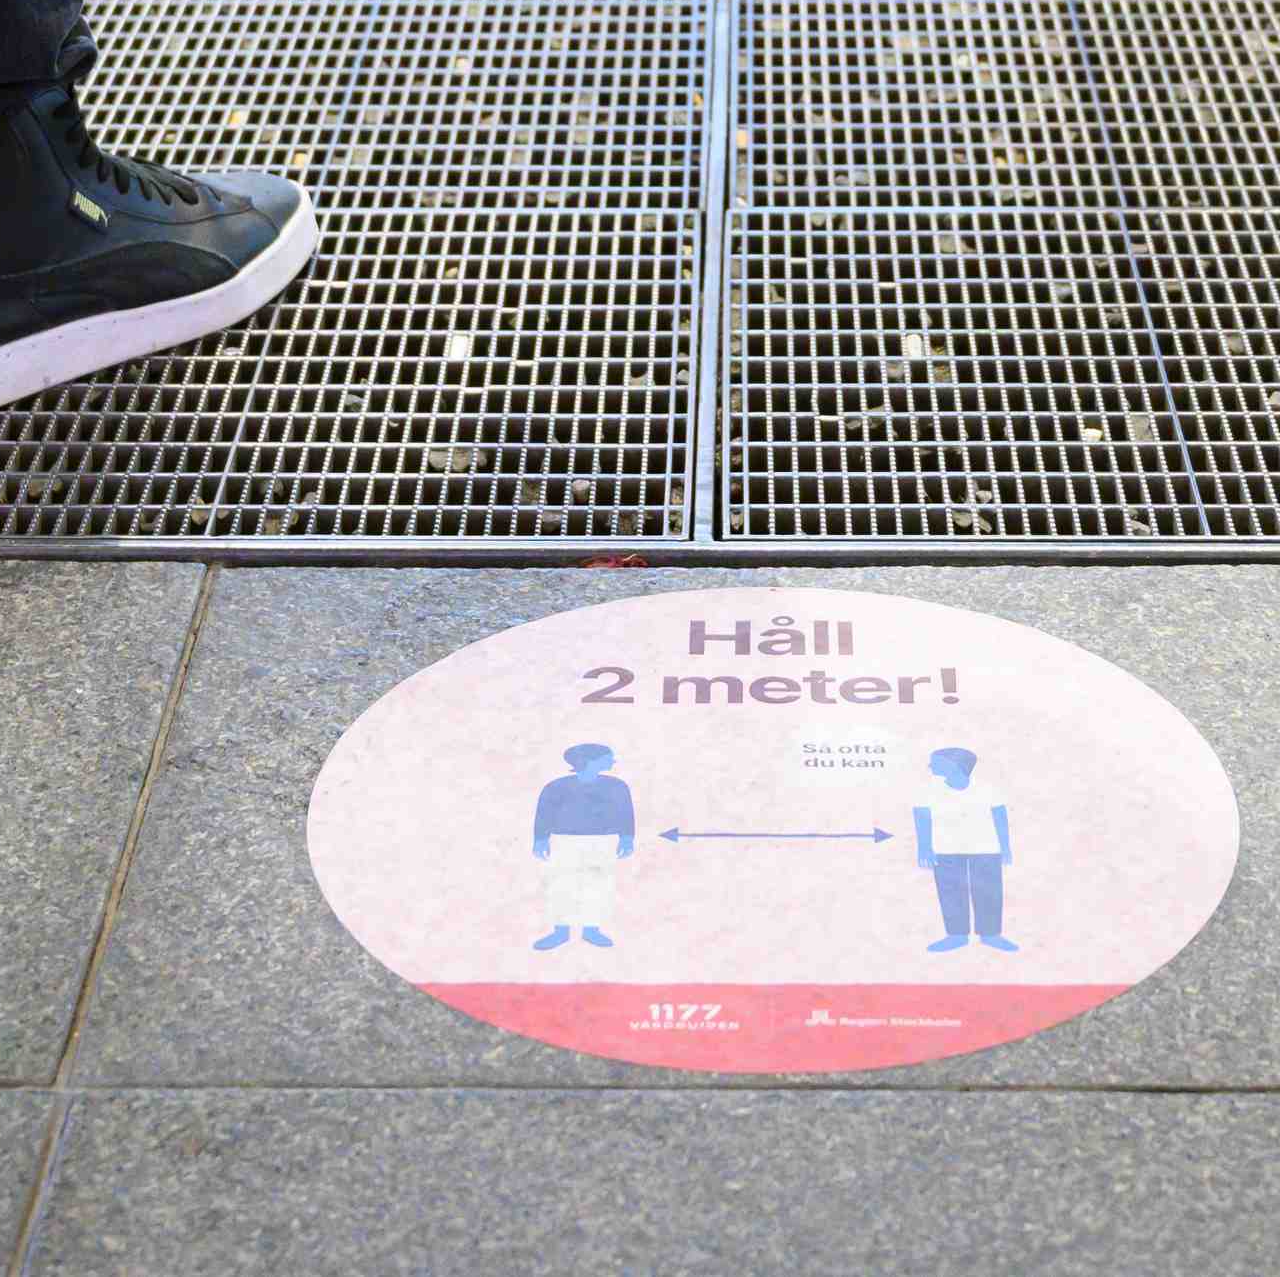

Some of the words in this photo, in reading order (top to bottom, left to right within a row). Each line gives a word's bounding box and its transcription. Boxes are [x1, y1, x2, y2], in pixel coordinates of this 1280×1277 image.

[688, 615, 854, 656] Håll
[580, 666, 636, 705] 2
[662, 667, 961, 705] meter!
[838, 743, 886, 754] ofta
[804, 757, 835, 768] du
[841, 757, 885, 768] kan
[648, 1003, 723, 1021] 1177
